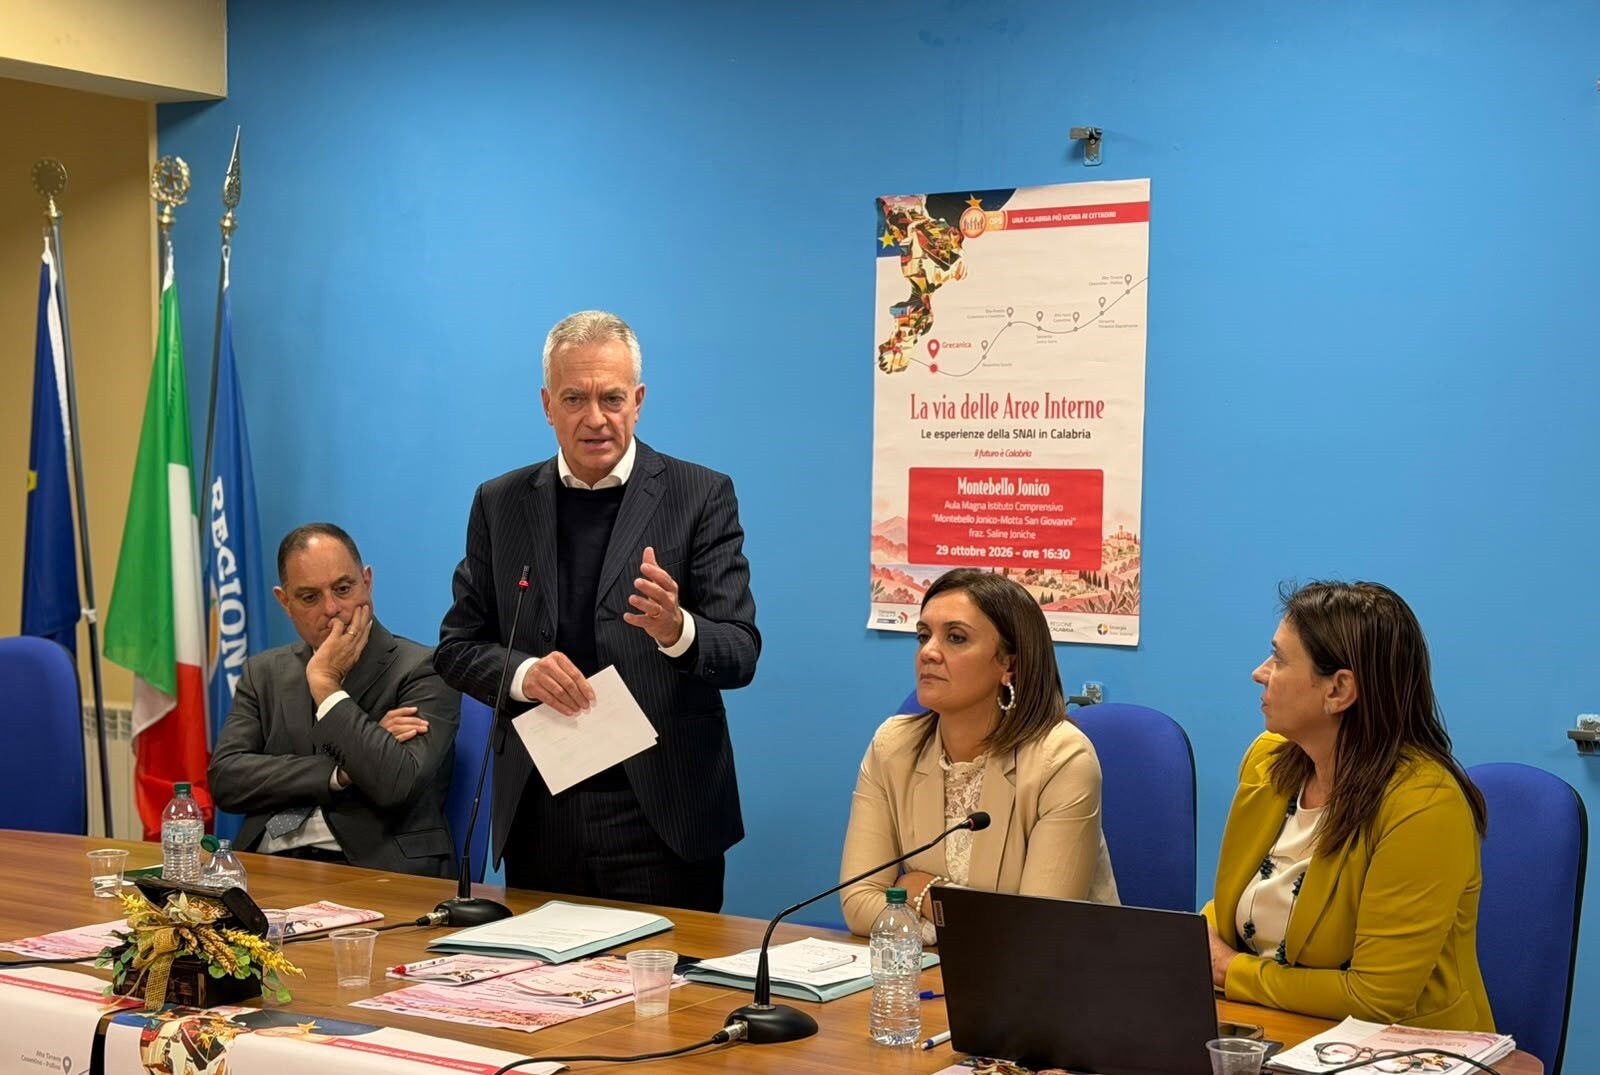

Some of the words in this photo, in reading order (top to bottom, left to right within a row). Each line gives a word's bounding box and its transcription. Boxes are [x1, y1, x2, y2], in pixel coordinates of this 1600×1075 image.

[1024, 215, 1051, 224] CALABRIA
[1089, 211, 1117, 220] CITTADINI
[942, 341, 972, 349] Grecanica
[910, 393, 928, 420] La
[932, 394, 956, 420] via
[960, 392, 999, 420] delle
[1002, 392, 1040, 420] Aree
[1044, 392, 1105, 420] Interne
[921, 429, 932, 439] Le
[934, 429, 984, 442] esperienze
[986, 428, 1010, 439] della
[1012, 428, 1036, 439] SNAI
[1038, 428, 1048, 439] in
[1050, 428, 1091, 439] Calabria
[978, 449, 999, 459] futuro
[1000, 449, 1005, 457] è
[1005, 449, 1032, 458] Calabria
[957, 476, 1014, 496] Montebello
[1016, 477, 1050, 497] Jonico
[944, 500, 961, 510] Aula
[961, 501, 987, 513] Magna
[987, 501, 1014, 511] Istituto
[1015, 502, 1064, 513] Comprensivo
[931, 513, 975, 523] "Montebello
[975, 515, 1023, 525] Jonico-Motta
[1024, 515, 1039, 526] San
[1040, 516, 1077, 527] Giovanni"
[968, 528, 985, 538] fraz.
[986, 528, 1009, 539] Saline
[1009, 529, 1036, 540] Joniche
[936, 544, 949, 556] 29
[950, 545, 986, 557] ottobre
[988, 546, 1013, 558] 2026
[1022, 549, 1040, 559] ore
[1043, 548, 1071, 560] 16:30
[211, 475, 248, 699] REGION
